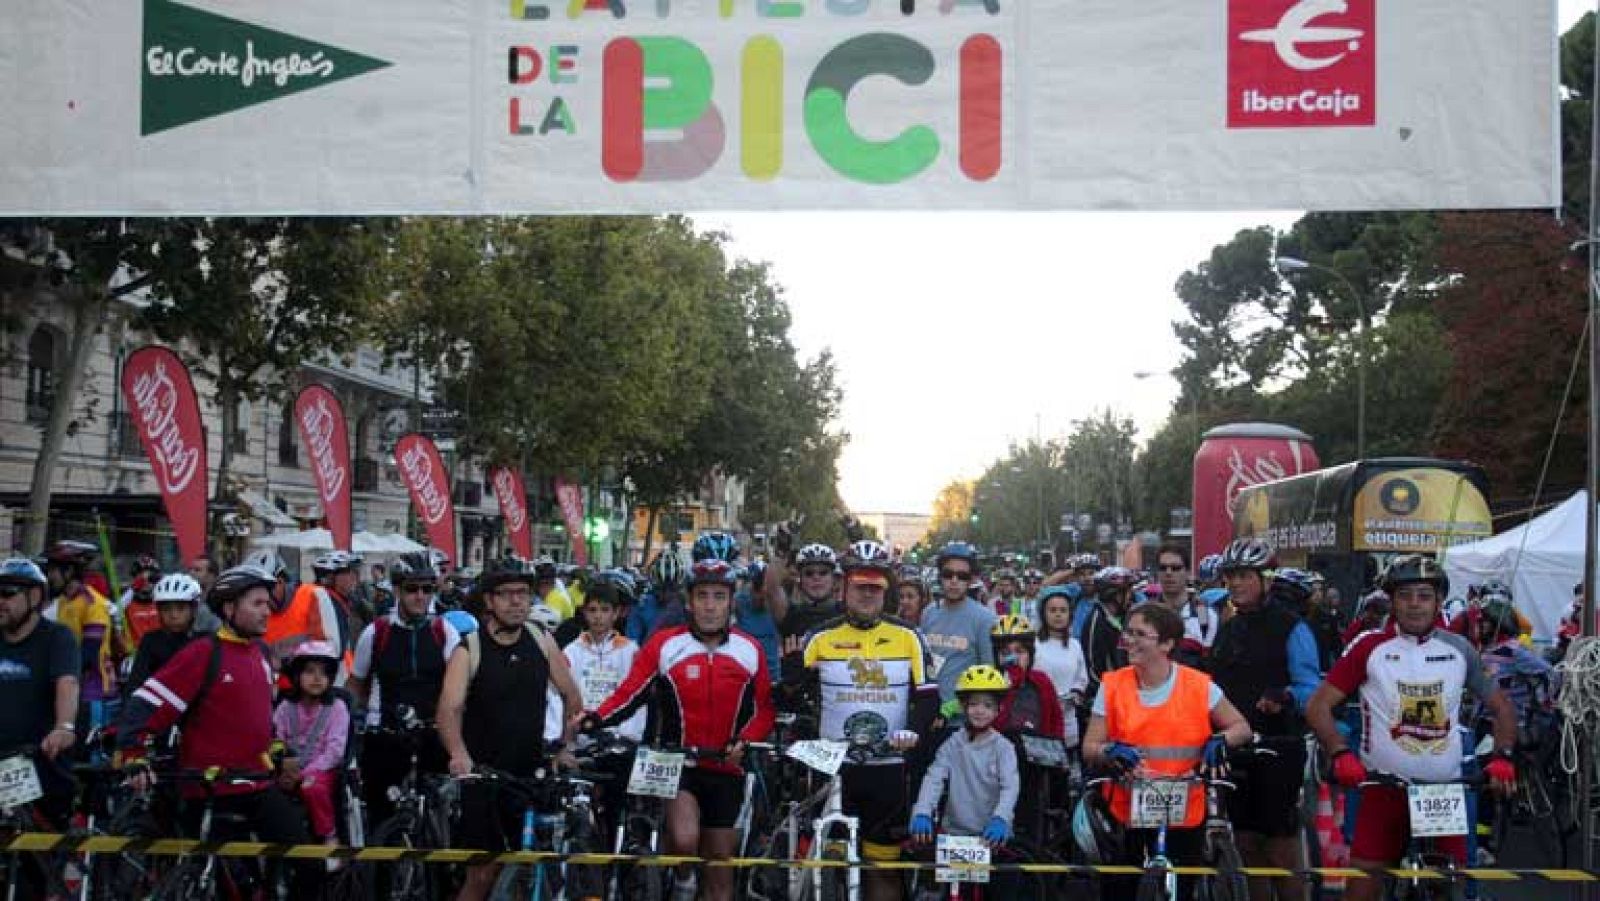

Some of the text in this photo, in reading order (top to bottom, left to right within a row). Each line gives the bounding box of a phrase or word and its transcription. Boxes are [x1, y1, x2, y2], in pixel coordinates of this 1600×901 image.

[147, 45, 174, 76] El
[176, 47, 240, 76] Corte
[508, 46, 578, 84] DE
[508, 97, 577, 135] LA
[602, 33, 1002, 184] BICI
[1416, 798, 1461, 812] 13827
